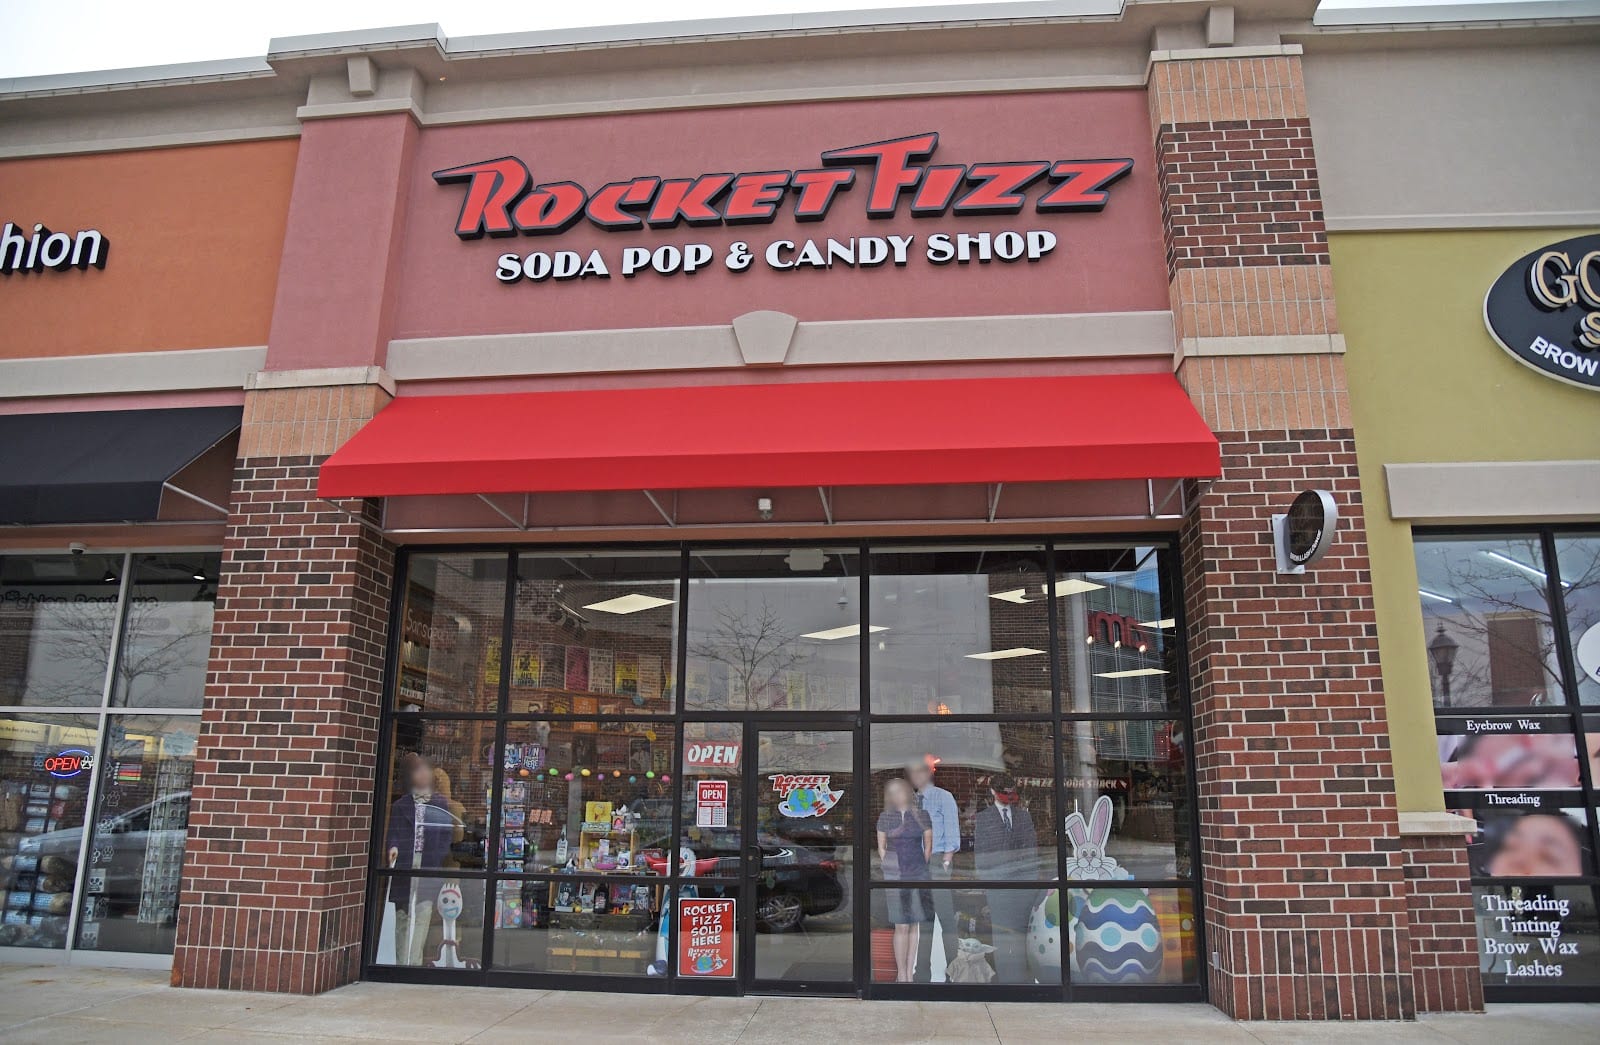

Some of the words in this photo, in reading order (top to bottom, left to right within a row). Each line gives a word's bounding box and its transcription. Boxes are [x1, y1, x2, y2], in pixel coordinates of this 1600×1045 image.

[431, 154, 855, 239] ROCKET
[822, 131, 1134, 219] FIZZ
[0, 222, 107, 271] hion
[495, 248, 610, 281] SODA
[622, 243, 713, 276] POP
[725, 241, 755, 272] &
[764, 235, 915, 271] CANDY
[926, 230, 1057, 267] SHOP
[1529, 335, 1599, 377] BROW
[1466, 720, 1512, 732] Eyebrow
[1517, 719, 1541, 730] Wax
[687, 744, 738, 765] OPEN
[45, 757, 80, 771] OPEN
[769, 775, 829, 790] ROCKET
[702, 789, 723, 800] OPEN
[1485, 793, 1541, 808] Threading
[683, 902, 731, 917] ROCKET
[1481, 894, 1569, 917] Threading
[692, 914, 722, 926] FIZZ
[1496, 916, 1561, 938] Tinting
[690, 924, 723, 937] SOLD
[691, 935, 721, 947] HERE
[1484, 938, 1530, 955] Brow
[1539, 938, 1579, 955] Wax
[1505, 959, 1562, 977] Lashes
